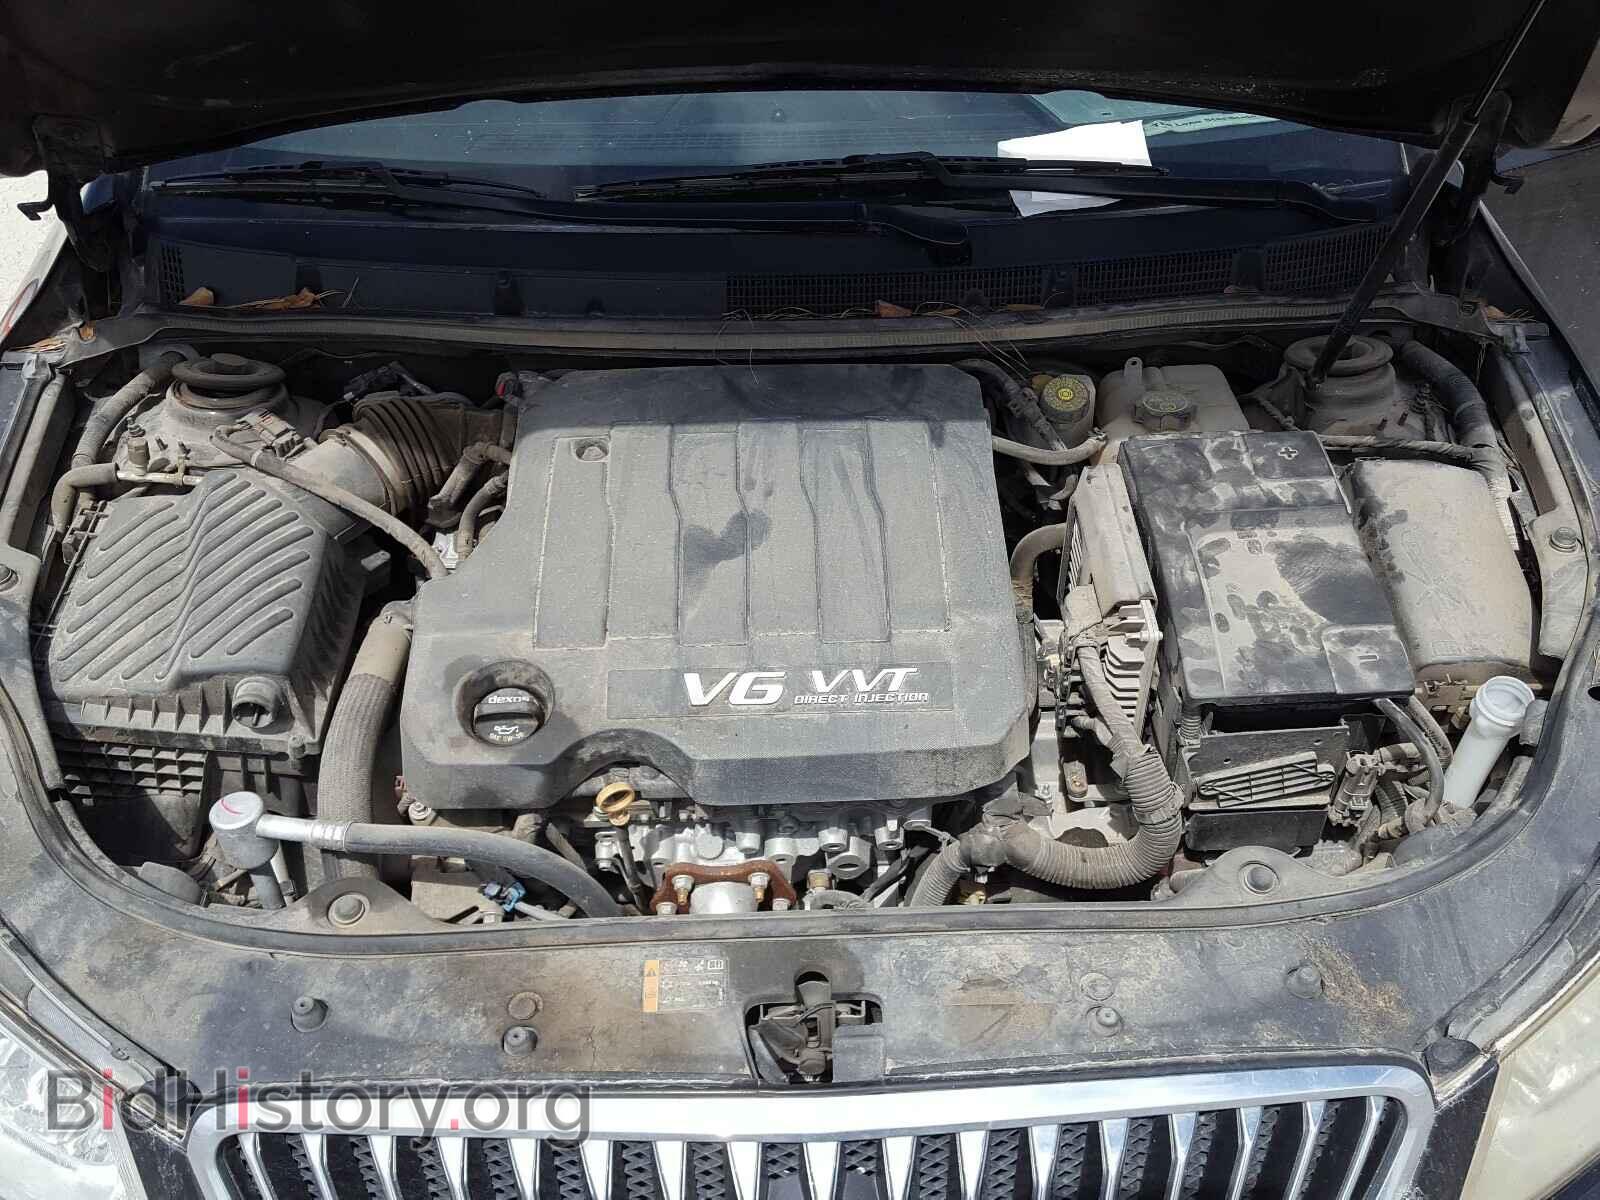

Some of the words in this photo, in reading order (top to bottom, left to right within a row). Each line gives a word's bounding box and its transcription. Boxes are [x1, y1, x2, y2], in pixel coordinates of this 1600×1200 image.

[684, 671, 786, 706] V6
[811, 667, 919, 692] VVT
[488, 695, 530, 704] dexos
[794, 694, 849, 705] DIRECT
[853, 692, 929, 704] INJECTION
